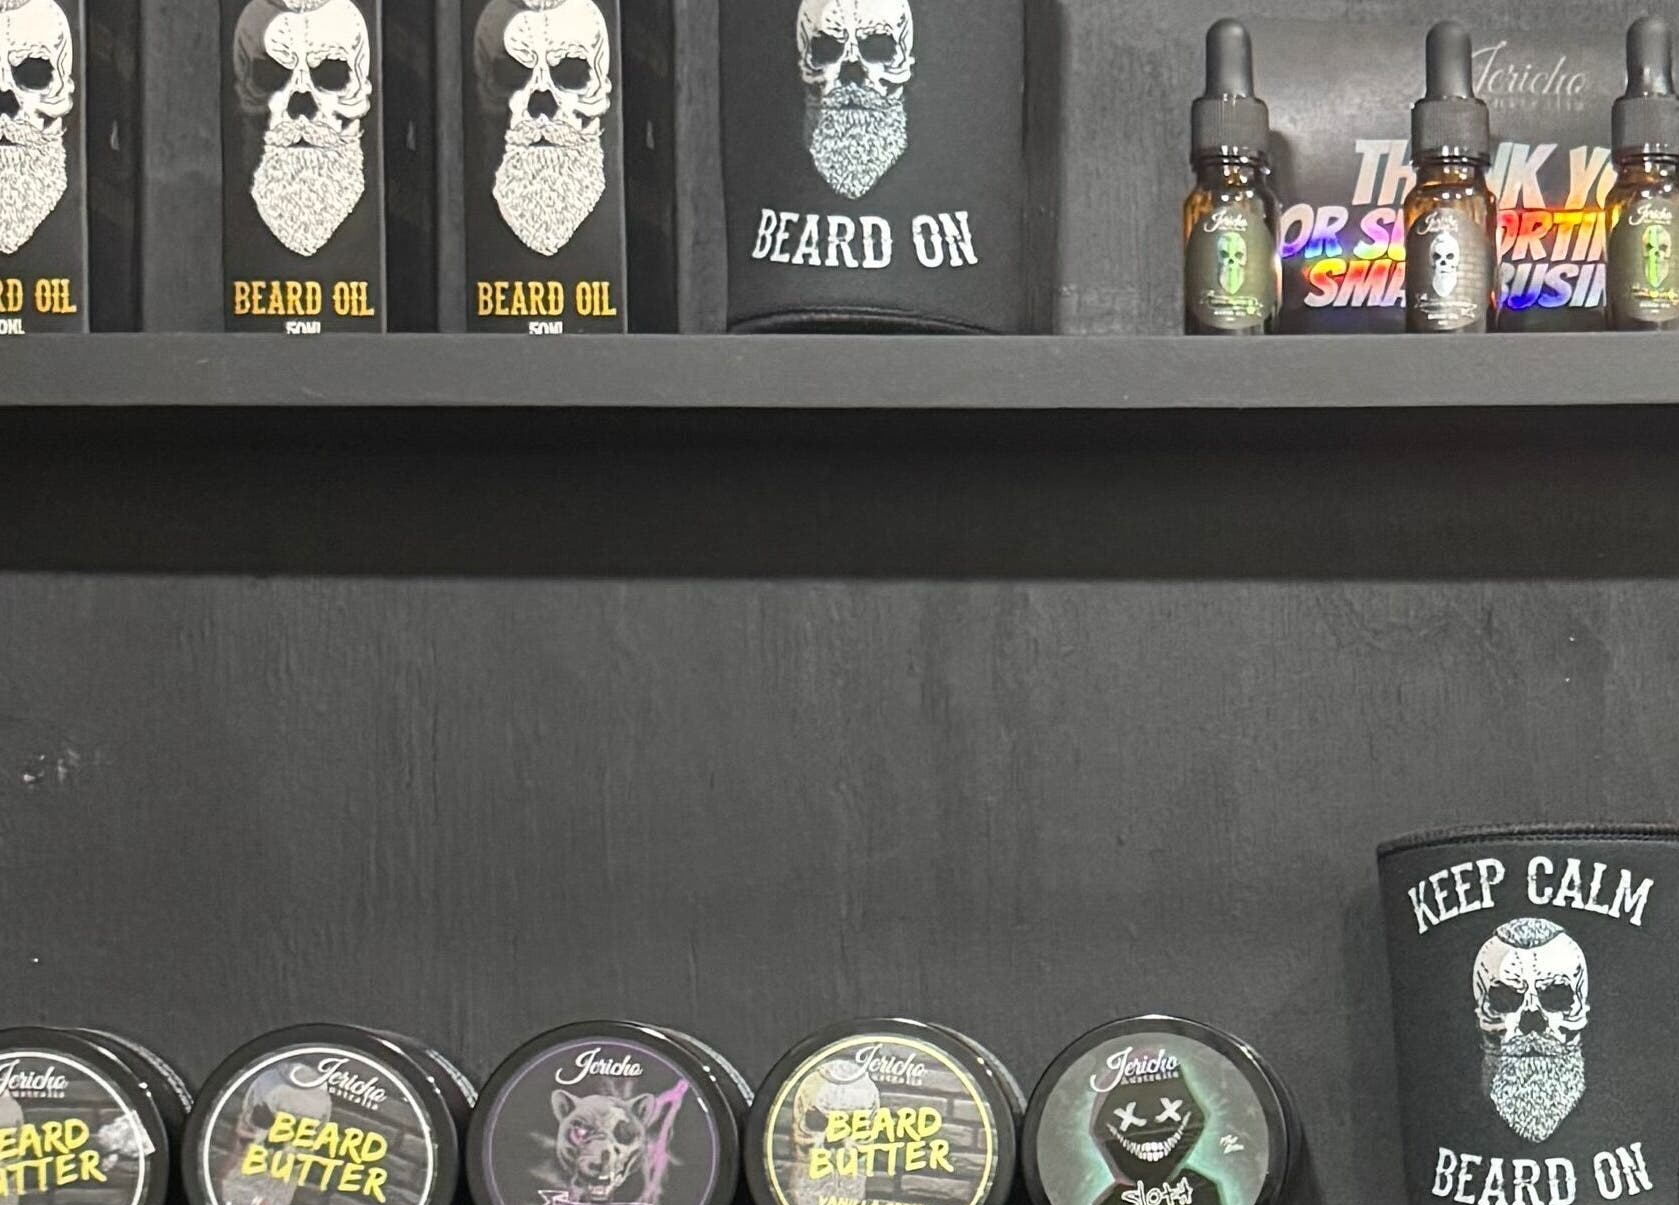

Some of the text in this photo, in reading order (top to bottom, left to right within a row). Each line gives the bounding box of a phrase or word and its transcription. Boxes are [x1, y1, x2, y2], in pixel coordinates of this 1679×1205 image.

[751, 208, 978, 269] BEARD ON
[35, 278, 77, 313] OIL
[234, 281, 375, 316] BEARD OIL
[477, 281, 617, 316] BEARD OIL
[0, 318, 25, 334] 0ML
[1408, 855, 1654, 934] KEEP CALM
[289, 1057, 387, 1103] Jericho
[555, 1048, 643, 1085] Jericho
[831, 1043, 928, 1084] Jericho
[1090, 1047, 1179, 1093] Jericho
[0, 1118, 89, 1161] EARD
[268, 1111, 388, 1164] BEARD
[825, 1107, 942, 1143] BEARD
[0, 1150, 107, 1197] TTER
[240, 1144, 388, 1203] BUTTER
[808, 1139, 954, 1180] BUTTER
[1593, 1142, 1654, 1200] ON
